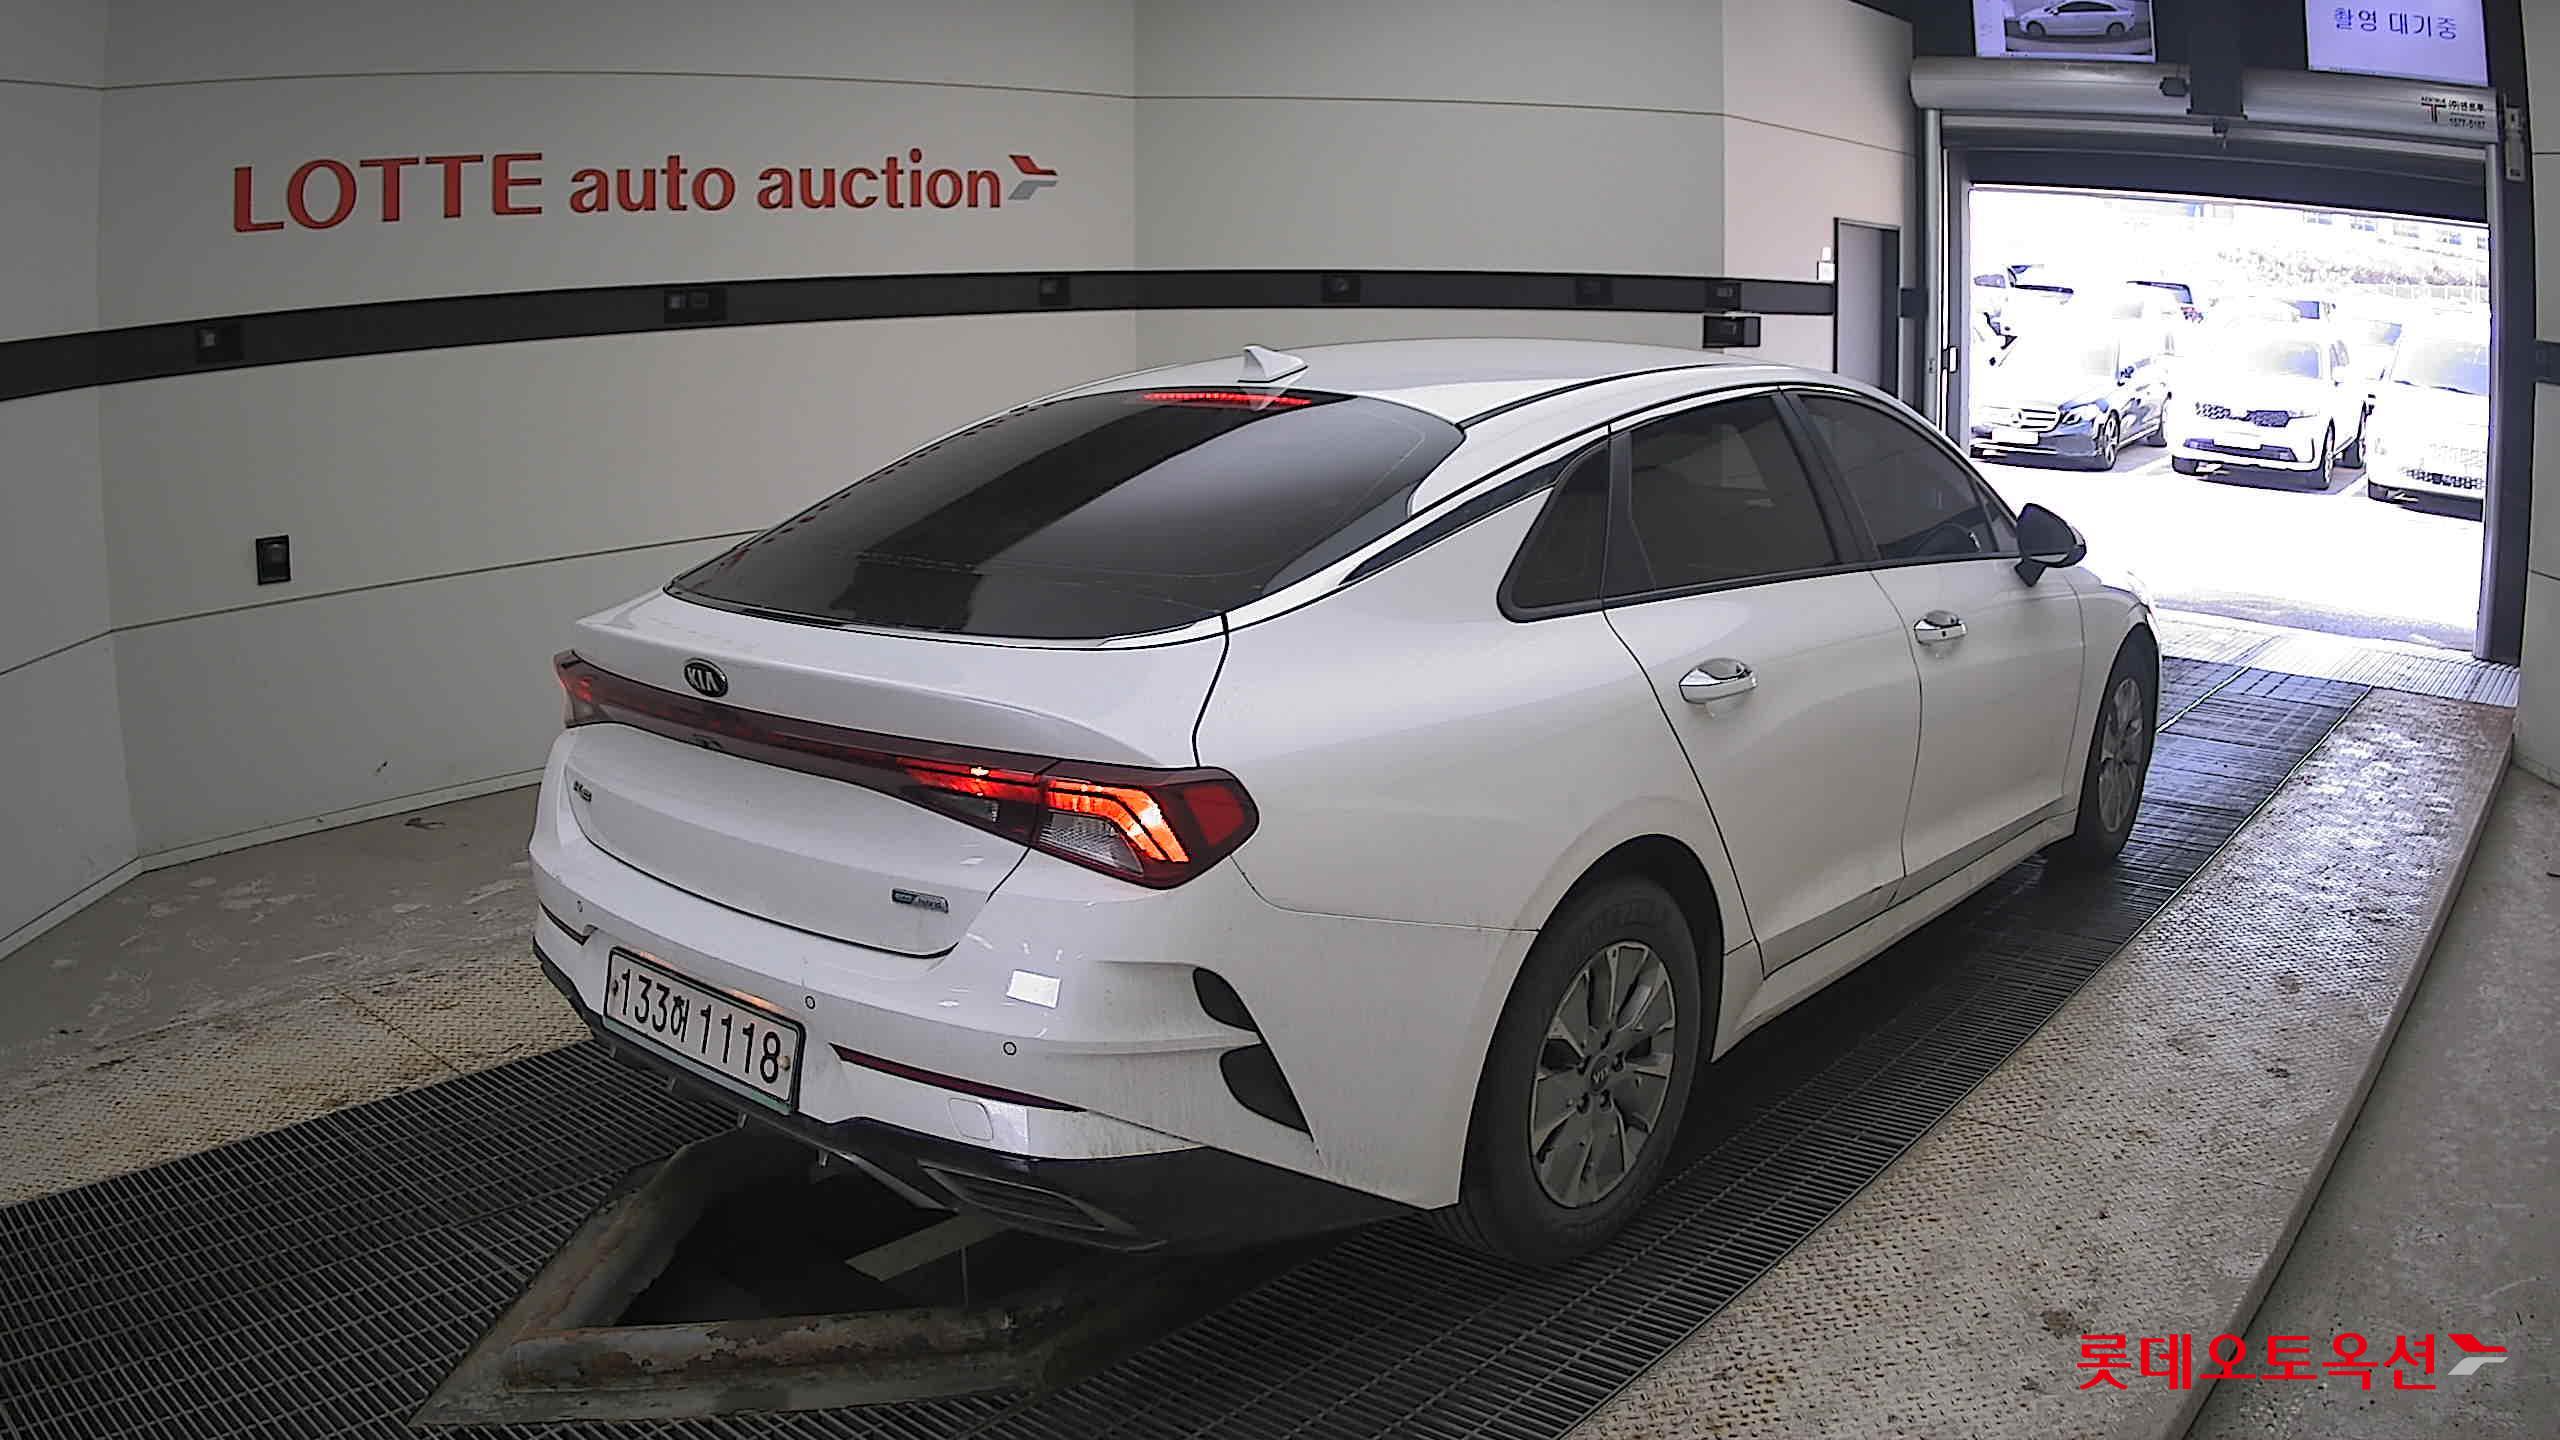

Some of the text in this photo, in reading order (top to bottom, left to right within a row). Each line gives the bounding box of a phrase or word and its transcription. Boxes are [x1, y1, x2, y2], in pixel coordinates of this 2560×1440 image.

[2389, 12, 2457, 40] 대기중
[235, 148, 1003, 233] LOTTE auto auction
[686, 667, 720, 692] KIA
[700, 1004, 781, 1084] 1118
